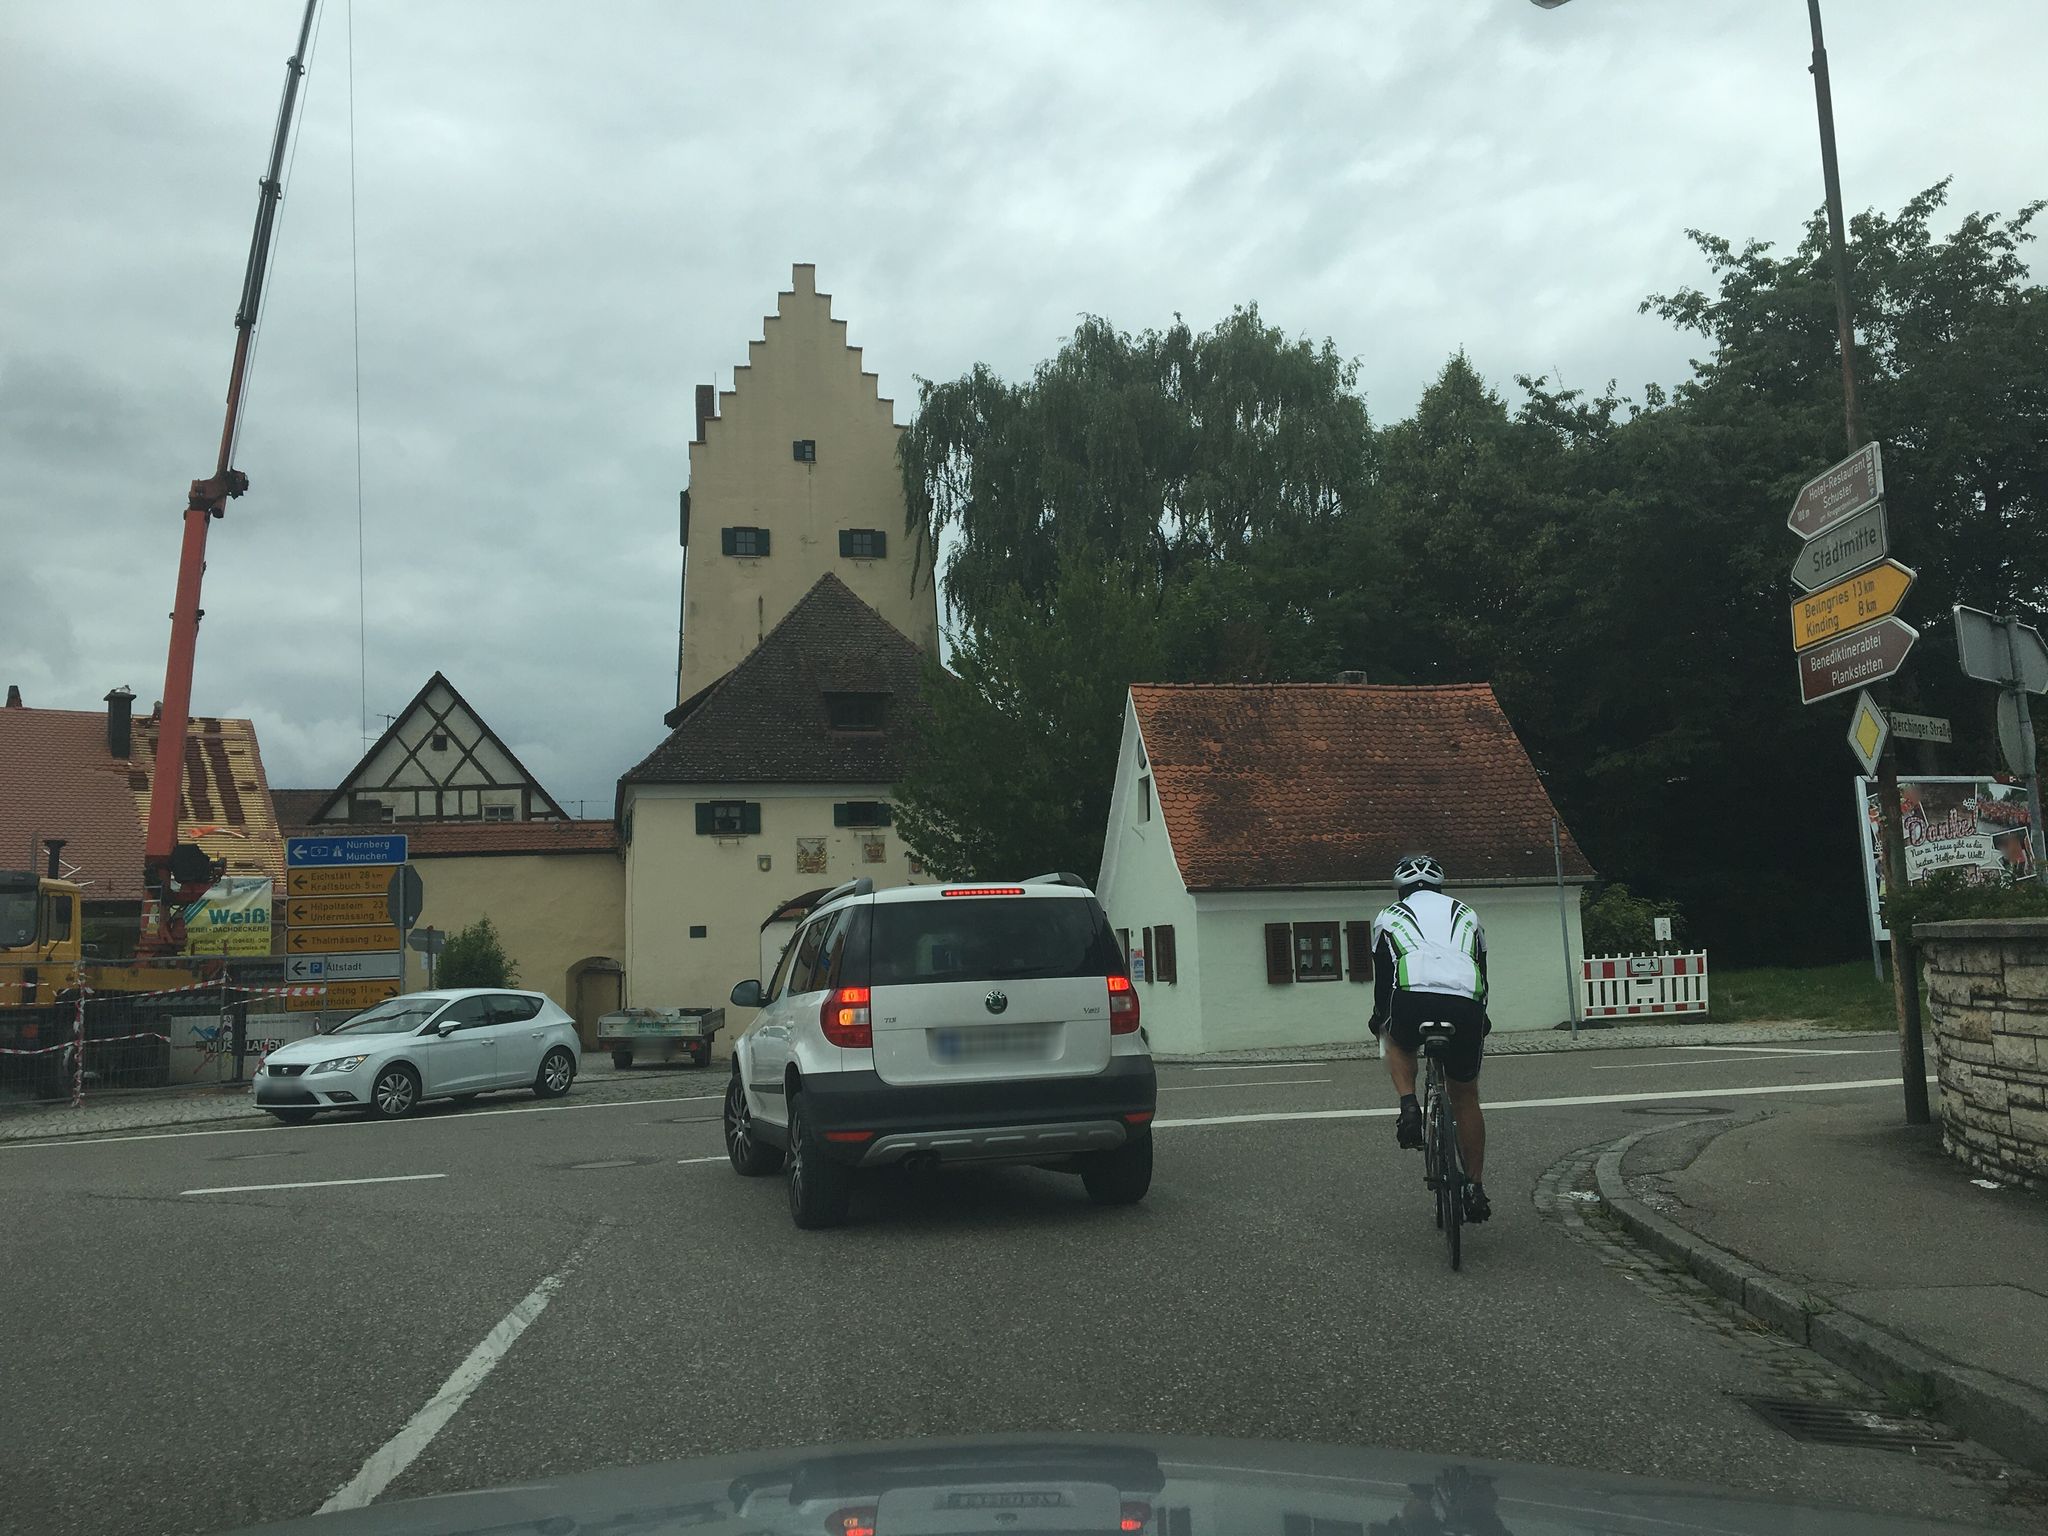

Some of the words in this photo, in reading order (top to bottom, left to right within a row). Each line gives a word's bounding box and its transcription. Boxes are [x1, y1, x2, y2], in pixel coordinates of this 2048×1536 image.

[1808, 457, 1866, 501] Hotel-Restaurant
[1822, 484, 1853, 508] Schuster
[1812, 527, 1877, 572] Stadtmitte
[1804, 590, 1849, 619] Beilngries
[1852, 581, 1863, 598] 13
[1864, 580, 1875, 593] km
[1806, 615, 1840, 638] Kinding
[1858, 600, 1864, 616] 8
[1865, 598, 1877, 613] km
[1810, 631, 1881, 672] Benediktinerabtei
[1831, 658, 1884, 686] Plankstetten
[1892, 716, 1929, 738] Berchinger
[1929, 720, 1952, 742] Straße
[1904, 807, 1978, 847] Danke!
[1910, 848, 1925, 858] Nur
[1932, 842, 1953, 852] Hause
[208, 908, 266, 925] Weiß
[373, 934, 383, 943] 12
[326, 962, 362, 971] Altstadt
